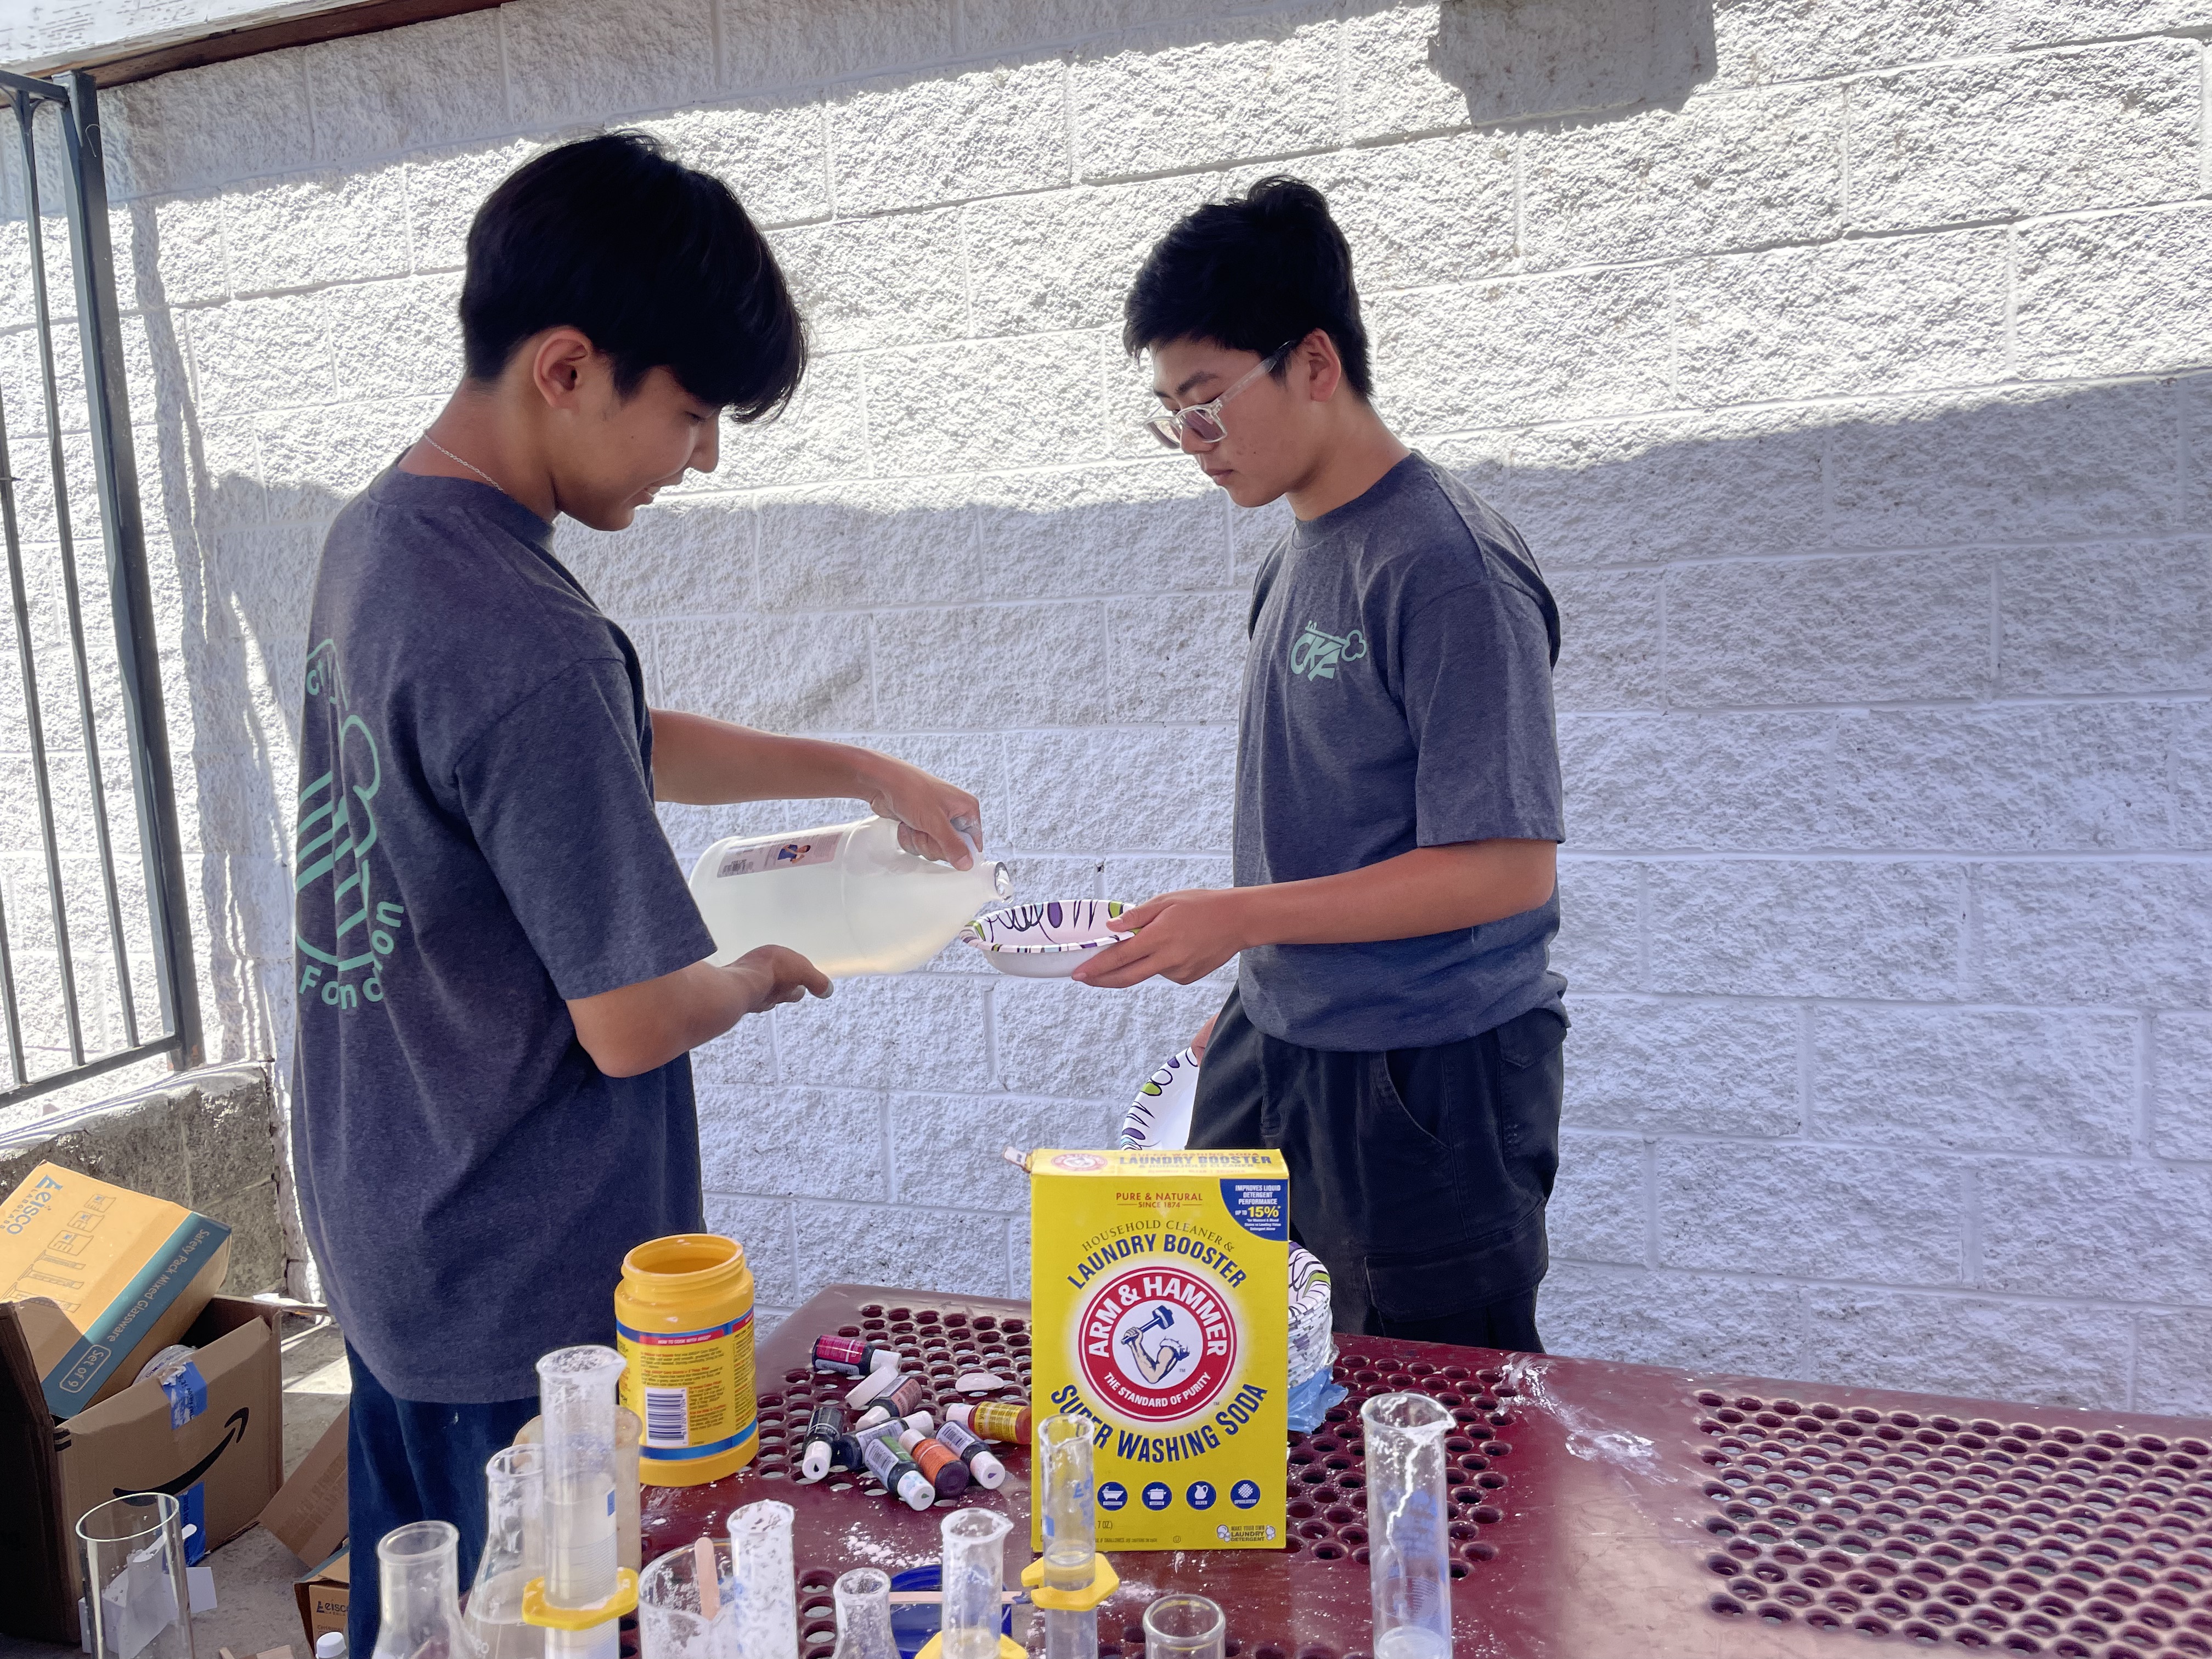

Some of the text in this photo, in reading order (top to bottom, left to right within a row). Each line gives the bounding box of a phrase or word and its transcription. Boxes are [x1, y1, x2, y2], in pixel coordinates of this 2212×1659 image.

[1120, 1155, 1272, 1164] LAUNDRY BOOSTER
[1116, 1192, 1141, 1200] PURE
[1155, 1192, 1203, 1201] NATURAL
[1081, 1220, 1235, 1252] HOUSEHOLD CLEANER &
[1067, 1233, 1247, 1290] LAUNDRY BOOSTER
[107, 1229, 210, 1342] Safety Pack Mixed Glassware
[1088, 1276, 1228, 1358] ARM & HAMMER
[74, 1367, 87, 1380] of
[83, 1349, 105, 1366] Set
[1103, 1372, 1212, 1408] THE STANDARD OF PURITY
[1116, 1425, 1221, 1463] WASHING
[1215, 1383, 1268, 1436] SODA
[1102, 1520, 1113, 1530] OZ.)
